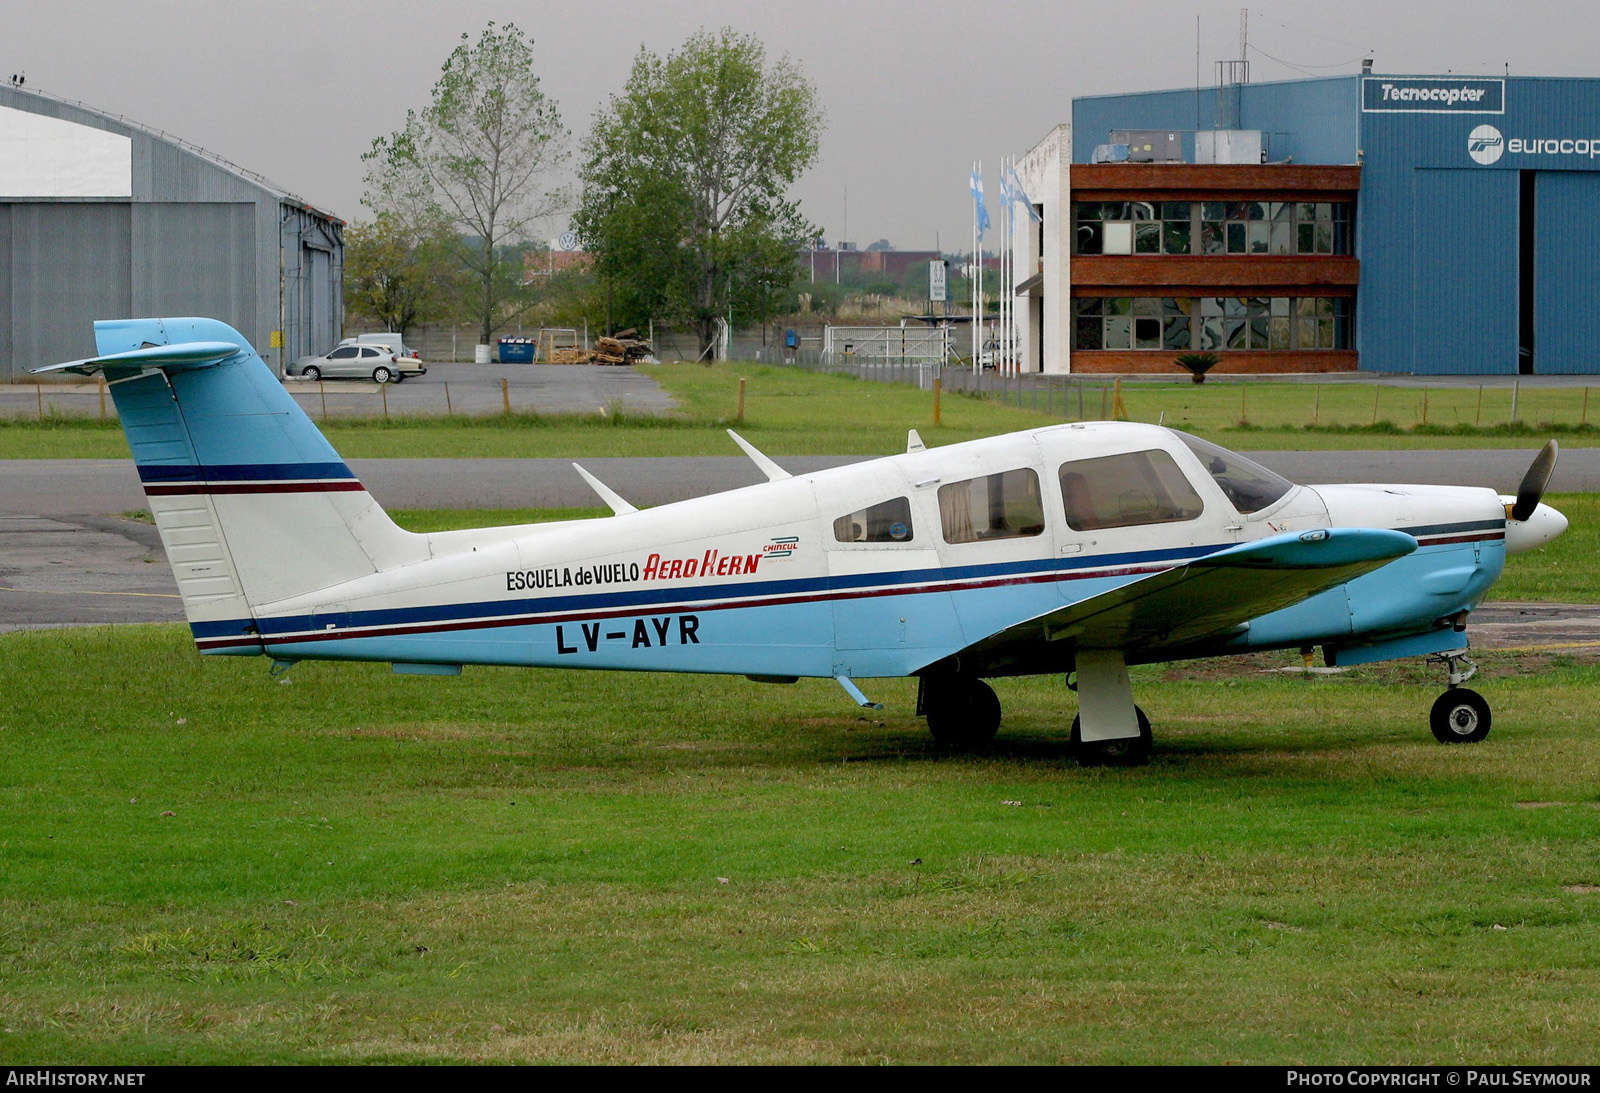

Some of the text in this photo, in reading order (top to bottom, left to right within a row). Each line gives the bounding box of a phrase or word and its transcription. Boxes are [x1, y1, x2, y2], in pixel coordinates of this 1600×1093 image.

[1381, 83, 1485, 106] Tecnocopter
[762, 543, 798, 552] CHINCUL
[506, 567, 573, 591] ESCUELA
[556, 614, 700, 655] LV-AYR
